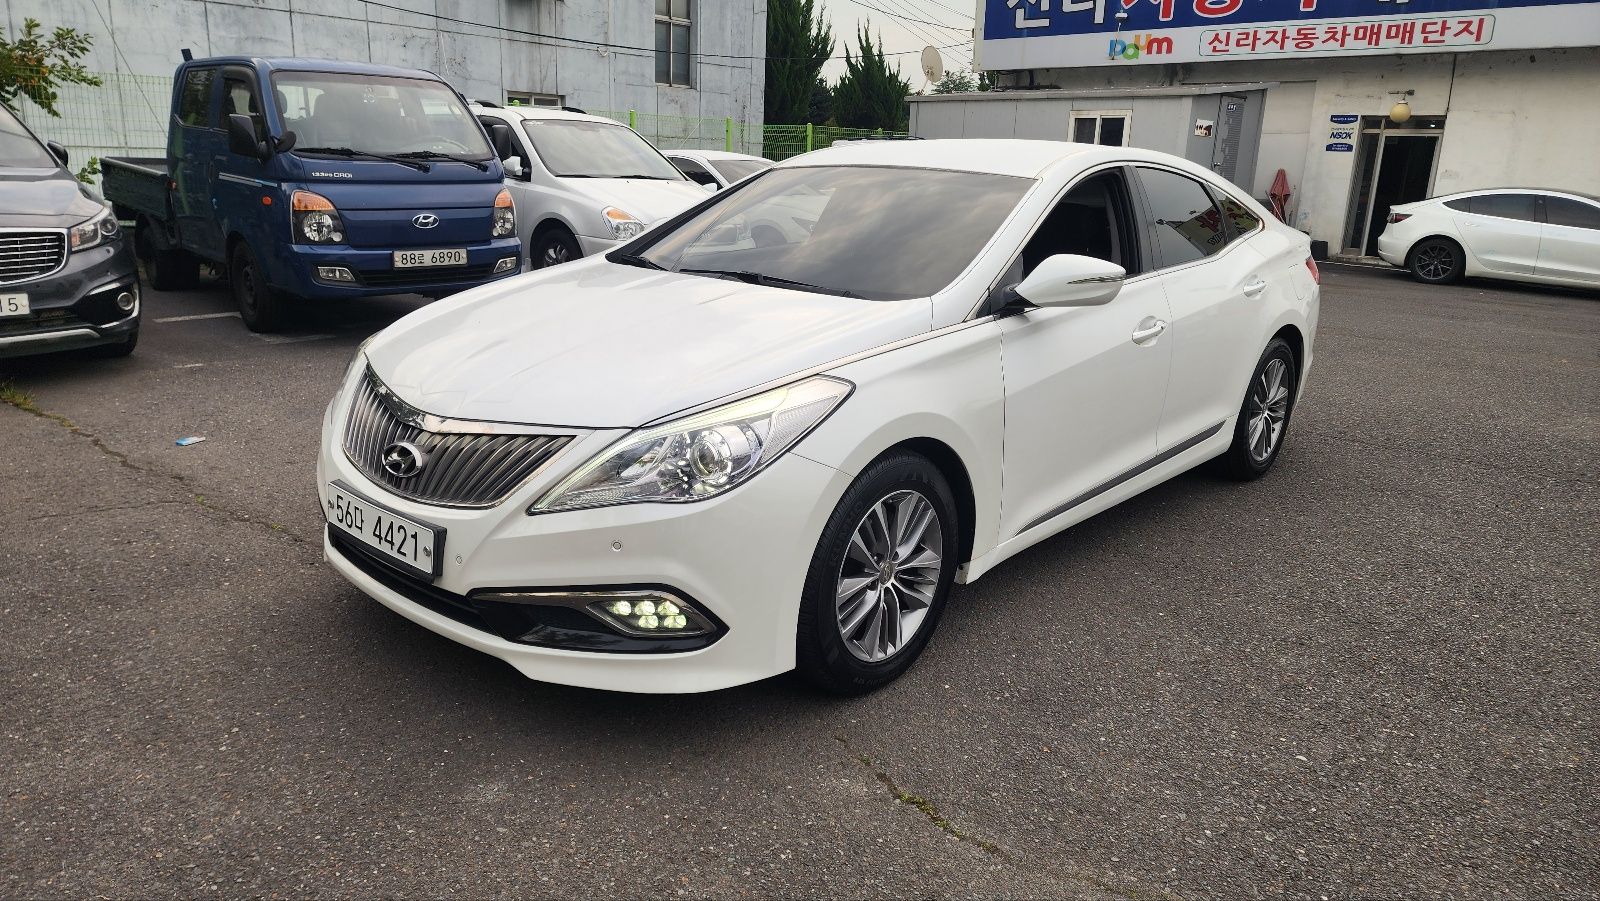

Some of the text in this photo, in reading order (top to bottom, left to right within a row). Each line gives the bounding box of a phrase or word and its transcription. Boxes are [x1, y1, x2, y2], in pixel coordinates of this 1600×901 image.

[1208, 17, 1485, 53] 신라자동차매매단지
[1330, 132, 1352, 140] NSOK
[401, 250, 461, 265] 88로 6890
[336, 494, 418, 561] 56다 4421
